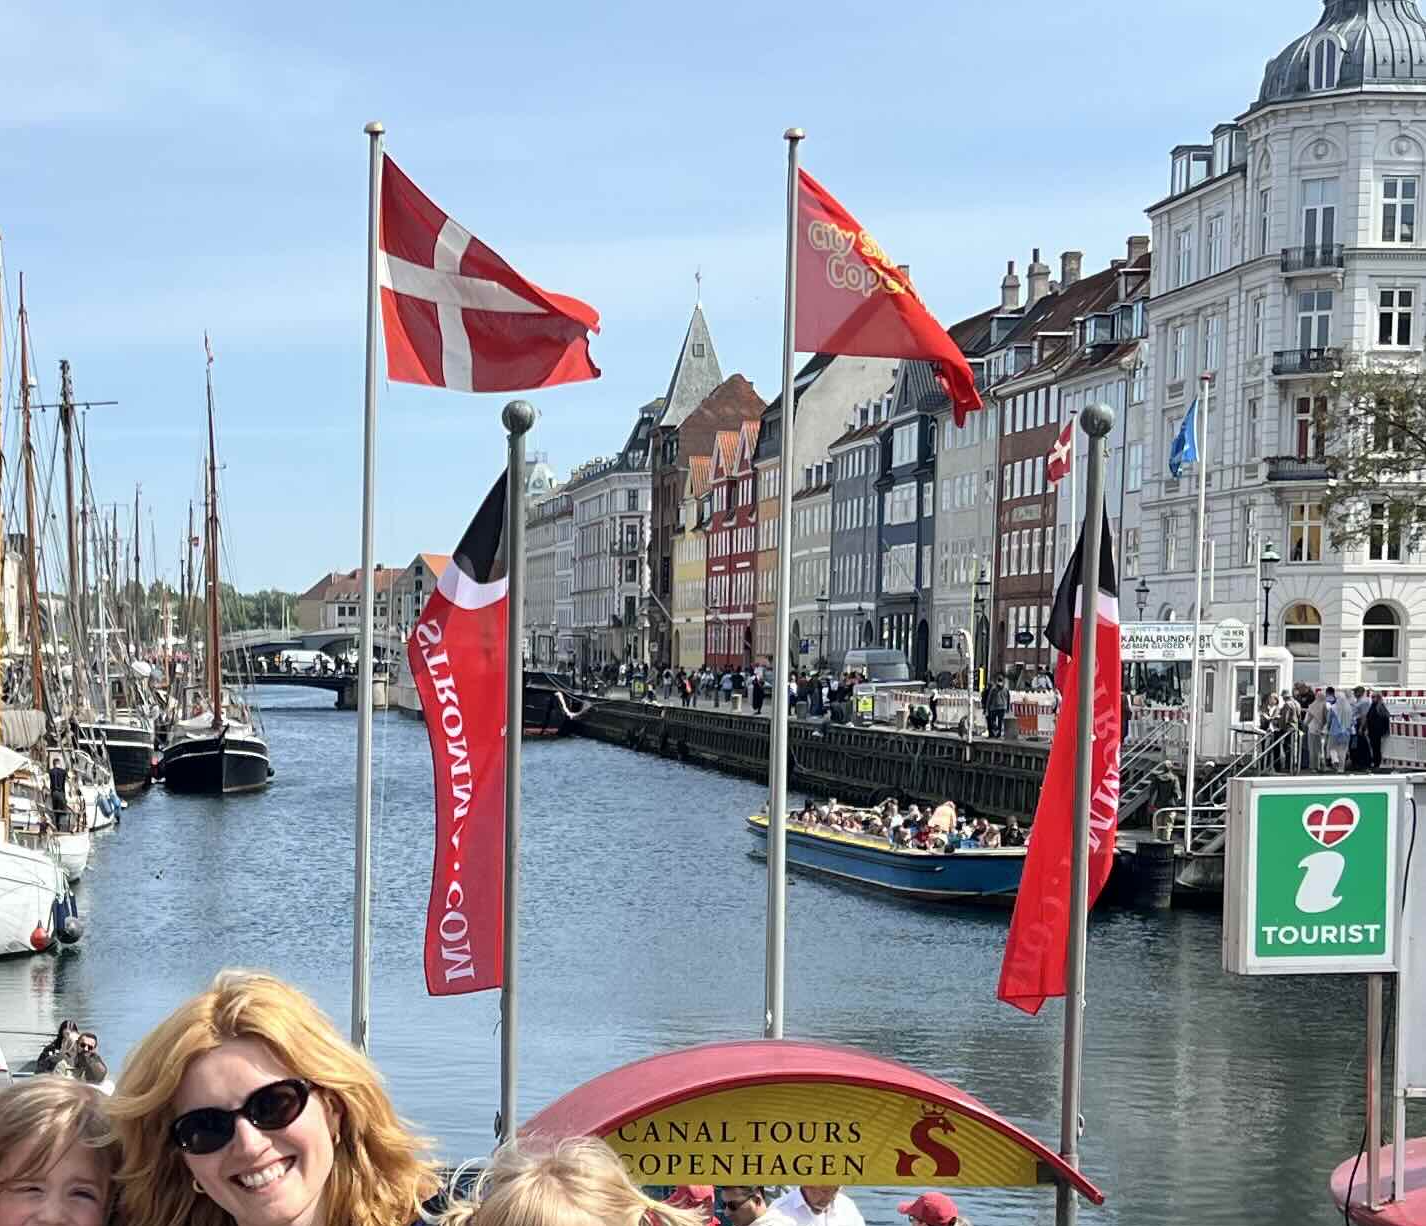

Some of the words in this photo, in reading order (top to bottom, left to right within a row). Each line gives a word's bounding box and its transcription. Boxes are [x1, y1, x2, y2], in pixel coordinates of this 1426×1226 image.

[808, 221, 856, 257] City
[1120, 635, 1213, 644] KANALRUNDFRT
[1261, 924, 1381, 945] TOURIST
[618, 1120, 736, 1143] CANAL
[747, 1120, 862, 1143] TOURS
[619, 1153, 865, 1176] COPENHAGEN
